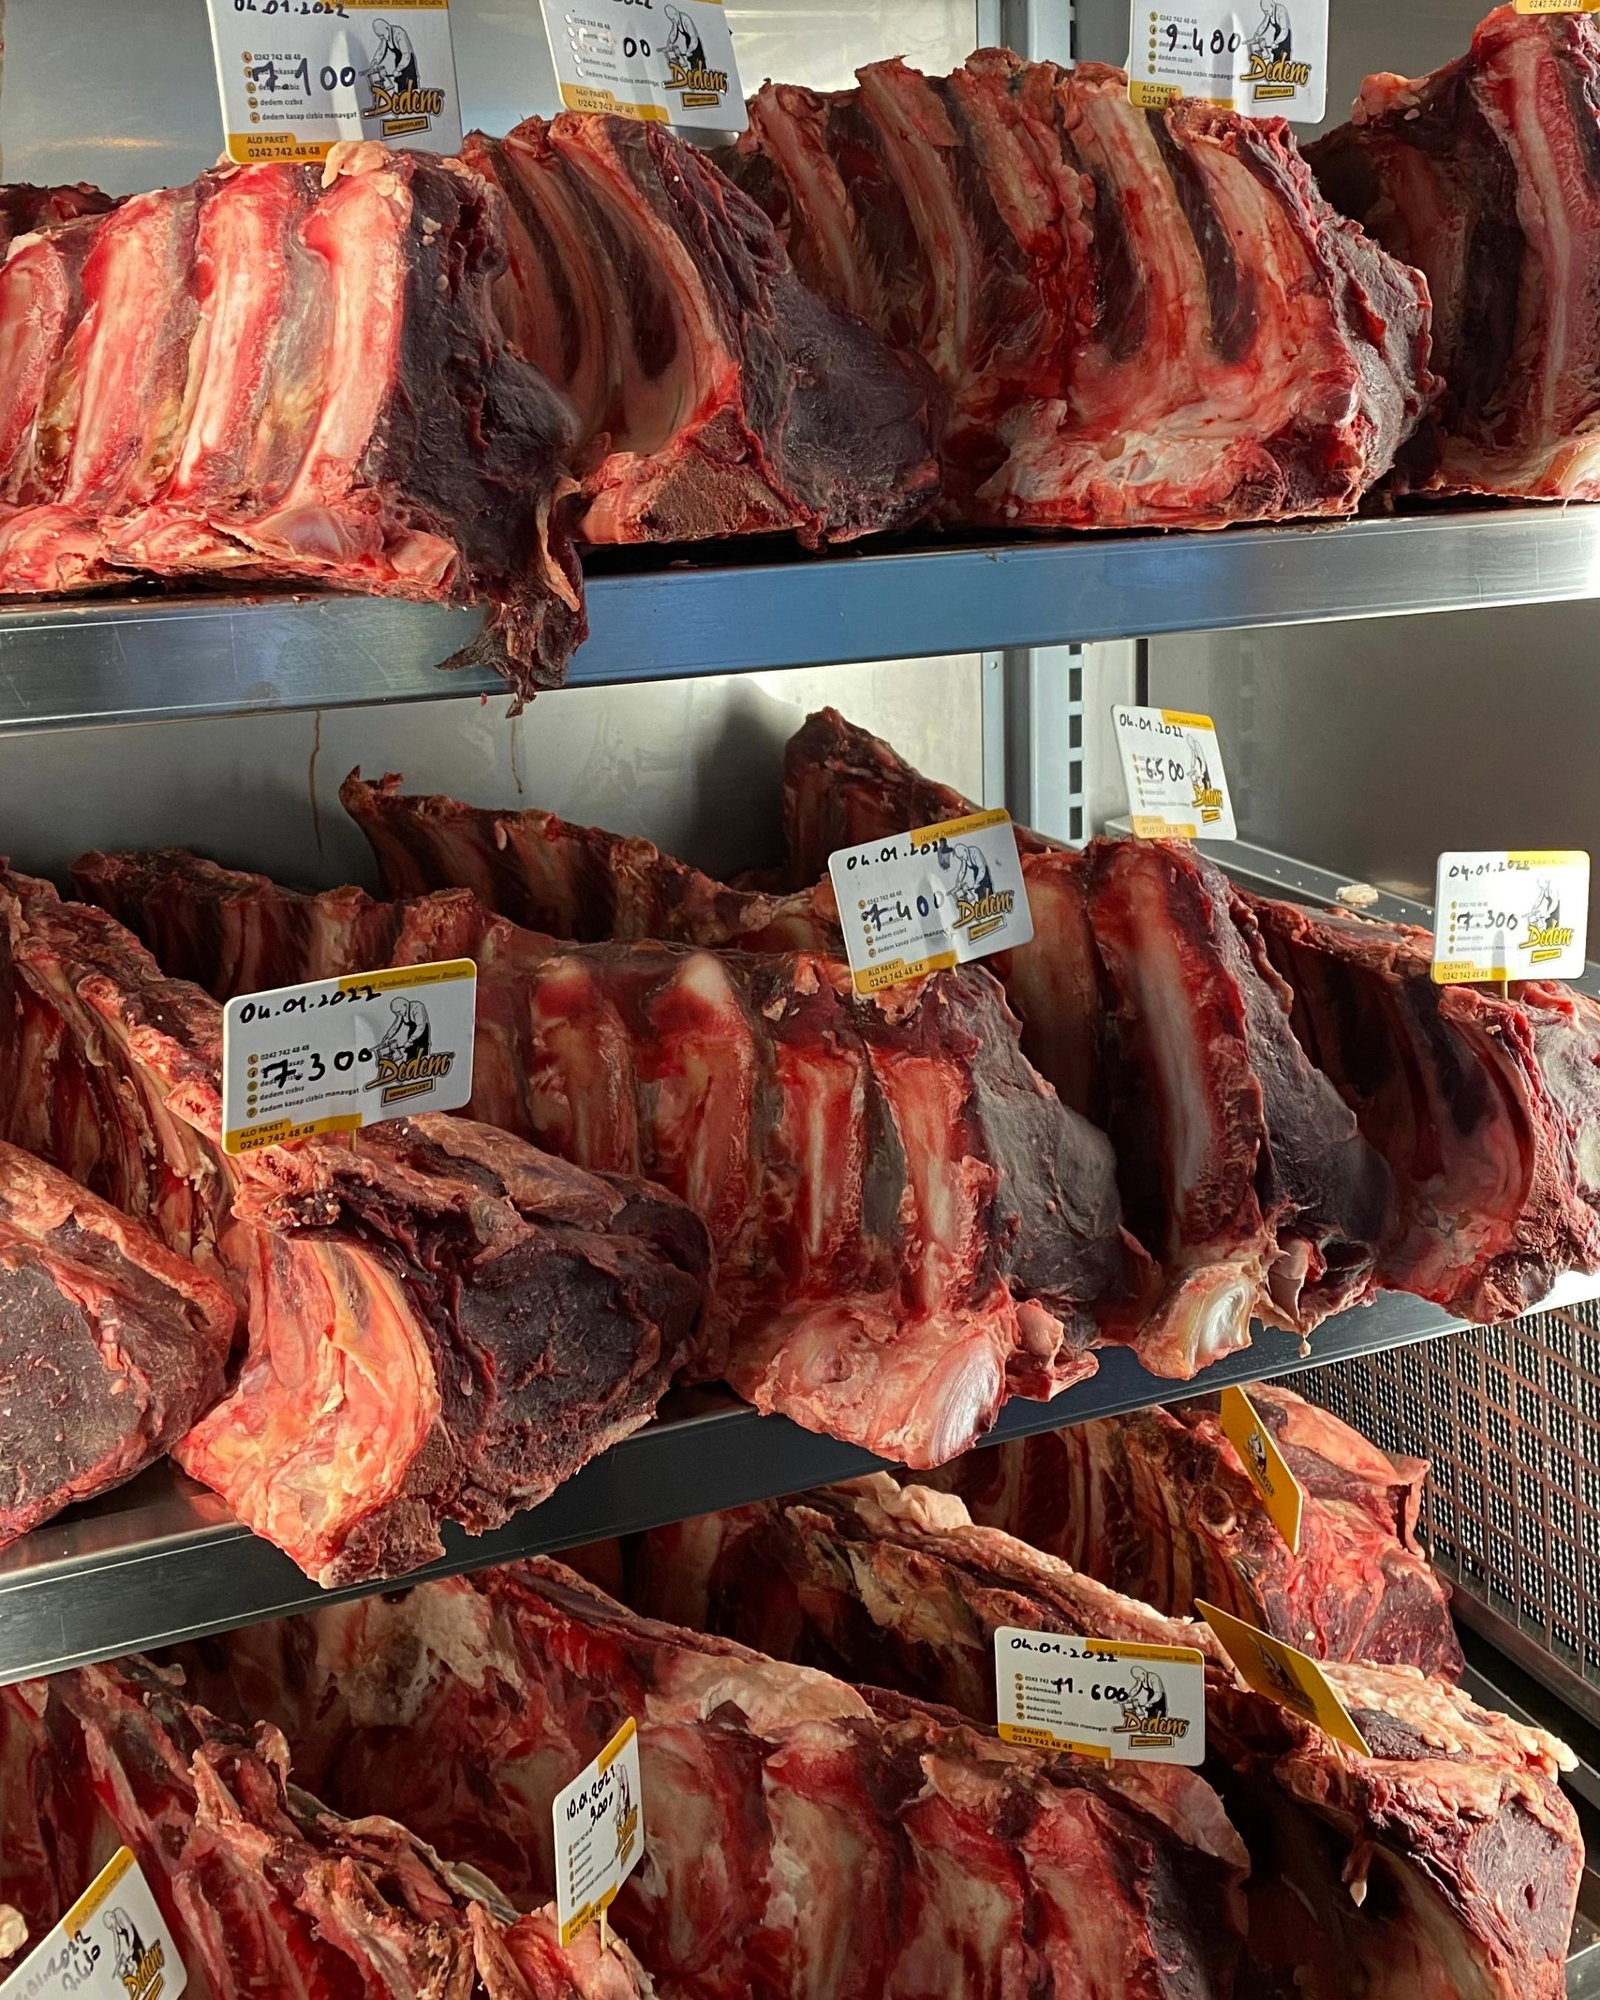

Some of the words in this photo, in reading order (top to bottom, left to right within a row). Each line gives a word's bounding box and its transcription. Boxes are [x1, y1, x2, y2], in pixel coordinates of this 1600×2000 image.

[663, 60, 727, 94] Dedem
[1240, 51, 1310, 85] Dedem
[363, 79, 440, 116] Dedem
[1142, 95, 1161, 105] 0242
[286, 113, 304, 122] kasap
[325, 112, 357, 121] manavgat
[247, 136, 262, 144] ALO
[264, 135, 289, 144] PAKET
[248, 148, 272, 157] 0242
[275, 147, 292, 156] 742
[295, 146, 306, 155] 48
[308, 146, 320, 155] 48
[953, 888, 1013, 929] Dedem
[1457, 910, 1518, 931] 7.300
[875, 932, 892, 941] dedem
[1519, 919, 1573, 949] Dedem
[881, 961, 899, 972] PAKET
[1443, 972, 1458, 980] 0242
[1460, 971, 1470, 979] 742
[870, 976, 888, 987] 0242
[889, 971, 903, 981] 742
[905, 966, 913, 975] 48
[239, 985, 382, 1024] 04.01.2022
[261, 1051, 277, 1060] 0242
[278, 1048, 290, 1057] 742
[365, 1048, 452, 1090] Dedem
[259, 1103, 283, 1113] dedem
[284, 1098, 304, 1108] kasap
[324, 1088, 360, 1097] manavgat
[260, 1089, 284, 1100] dedem
[240, 1128, 257, 1138] ALO
[258, 1122, 284, 1134] PAKET
[240, 1137, 264, 1150] 0242
[267, 1132, 286, 1143] 742
[288, 1128, 300, 1138] 48
[303, 1125, 315, 1134] 48
[1011, 1638, 1119, 1662] 04.01.2022
[1026, 1728, 1047, 1737] PAKET
[1046, 1717, 1063, 1726] kasap
[1080, 1724, 1108, 1732] manavgat
[1113, 1710, 1185, 1737] Dedem
[1012, 1734, 1032, 1743] 0242
[1034, 1737, 1049, 1747] 742
[1051, 1740, 1061, 1748] 48
[1062, 1742, 1073, 1750] 48
